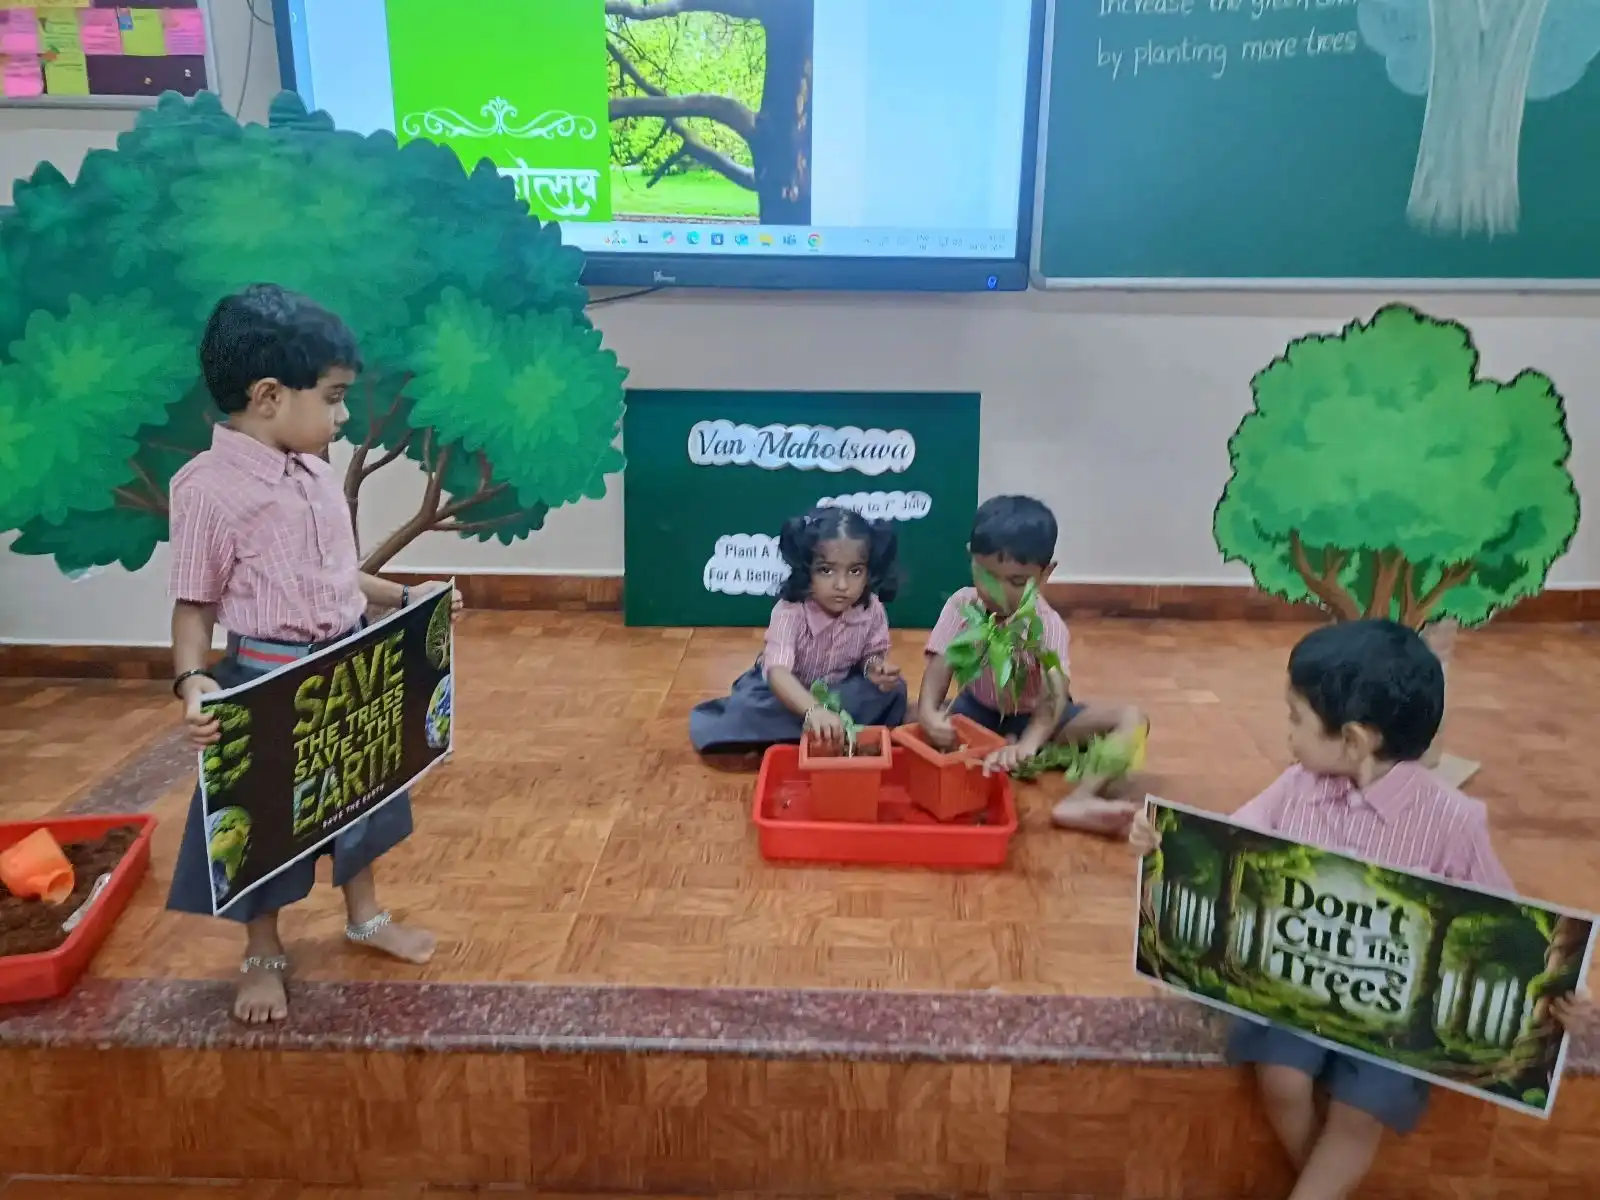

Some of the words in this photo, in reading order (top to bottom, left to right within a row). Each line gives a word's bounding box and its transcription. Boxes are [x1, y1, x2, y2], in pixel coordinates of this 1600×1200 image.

[1097, 36, 1122, 80] by
[1134, 38, 1227, 78] planting
[1242, 37, 1297, 61] more
[698, 429, 746, 456] Van
[756, 430, 909, 460] Mahotsava
[725, 543, 757, 559] Plant
[761, 544, 770, 557] A
[709, 566, 729, 581] For
[733, 567, 741, 581] A
[747, 568, 784, 583] Better
[293, 629, 405, 736] SAVE
[294, 720, 341, 761] THE
[346, 682, 405, 733] TREES
[293, 721, 404, 837] EARTH
[323, 810, 345, 830] SAVE
[345, 798, 362, 815] THE
[1283, 875, 1410, 946] Don't
[1277, 913, 1355, 957] Cut
[1272, 945, 1408, 1012] Trees
